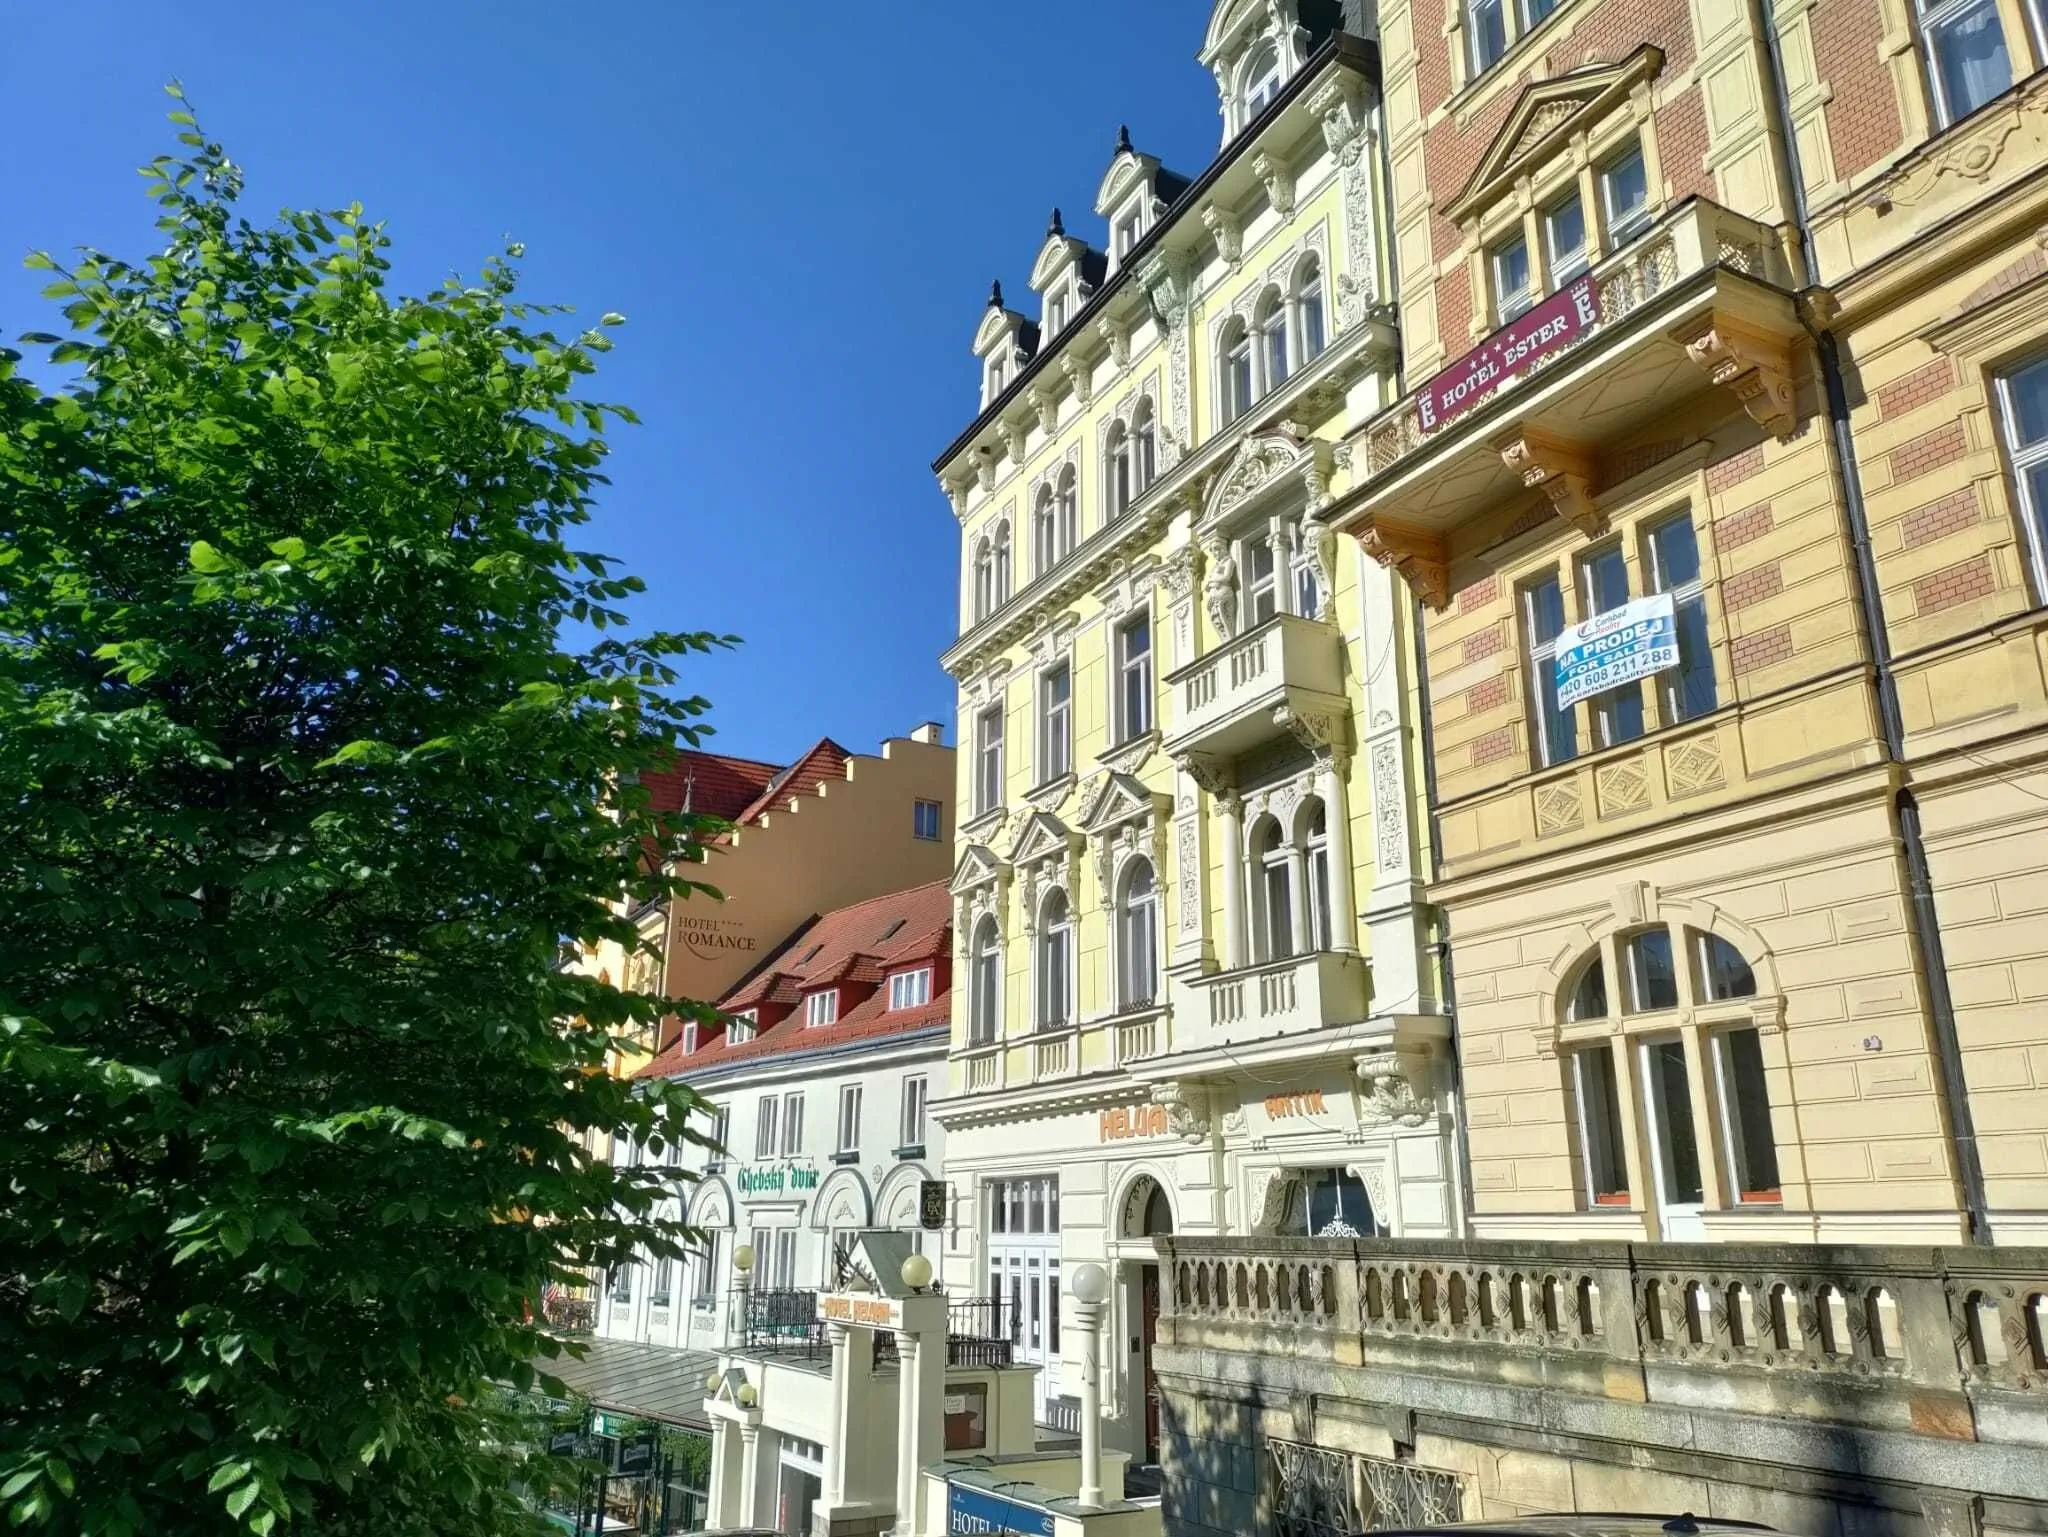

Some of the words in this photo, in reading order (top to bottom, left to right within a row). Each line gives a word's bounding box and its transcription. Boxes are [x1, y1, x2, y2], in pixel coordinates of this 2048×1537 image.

[1441, 361, 1500, 409] HOTEL
[1503, 314, 1569, 368] ESTER
[1594, 608, 1628, 627] Carlsbad
[1595, 621, 1621, 634] Reality
[1560, 651, 1578, 672] NA
[1582, 618, 1664, 655] PRODEJ
[1567, 660, 1600, 678] FOR
[1603, 640, 1648, 662] SALE
[1585, 667, 1609, 686] 608
[1612, 657, 1637, 676] 211
[1641, 647, 1673, 666] 288
[678, 916, 720, 932] HOTEL
[677, 930, 757, 953] ROMANCE
[737, 1165, 785, 1200] Chebský
[952, 1509, 991, 1535] HOTEL
